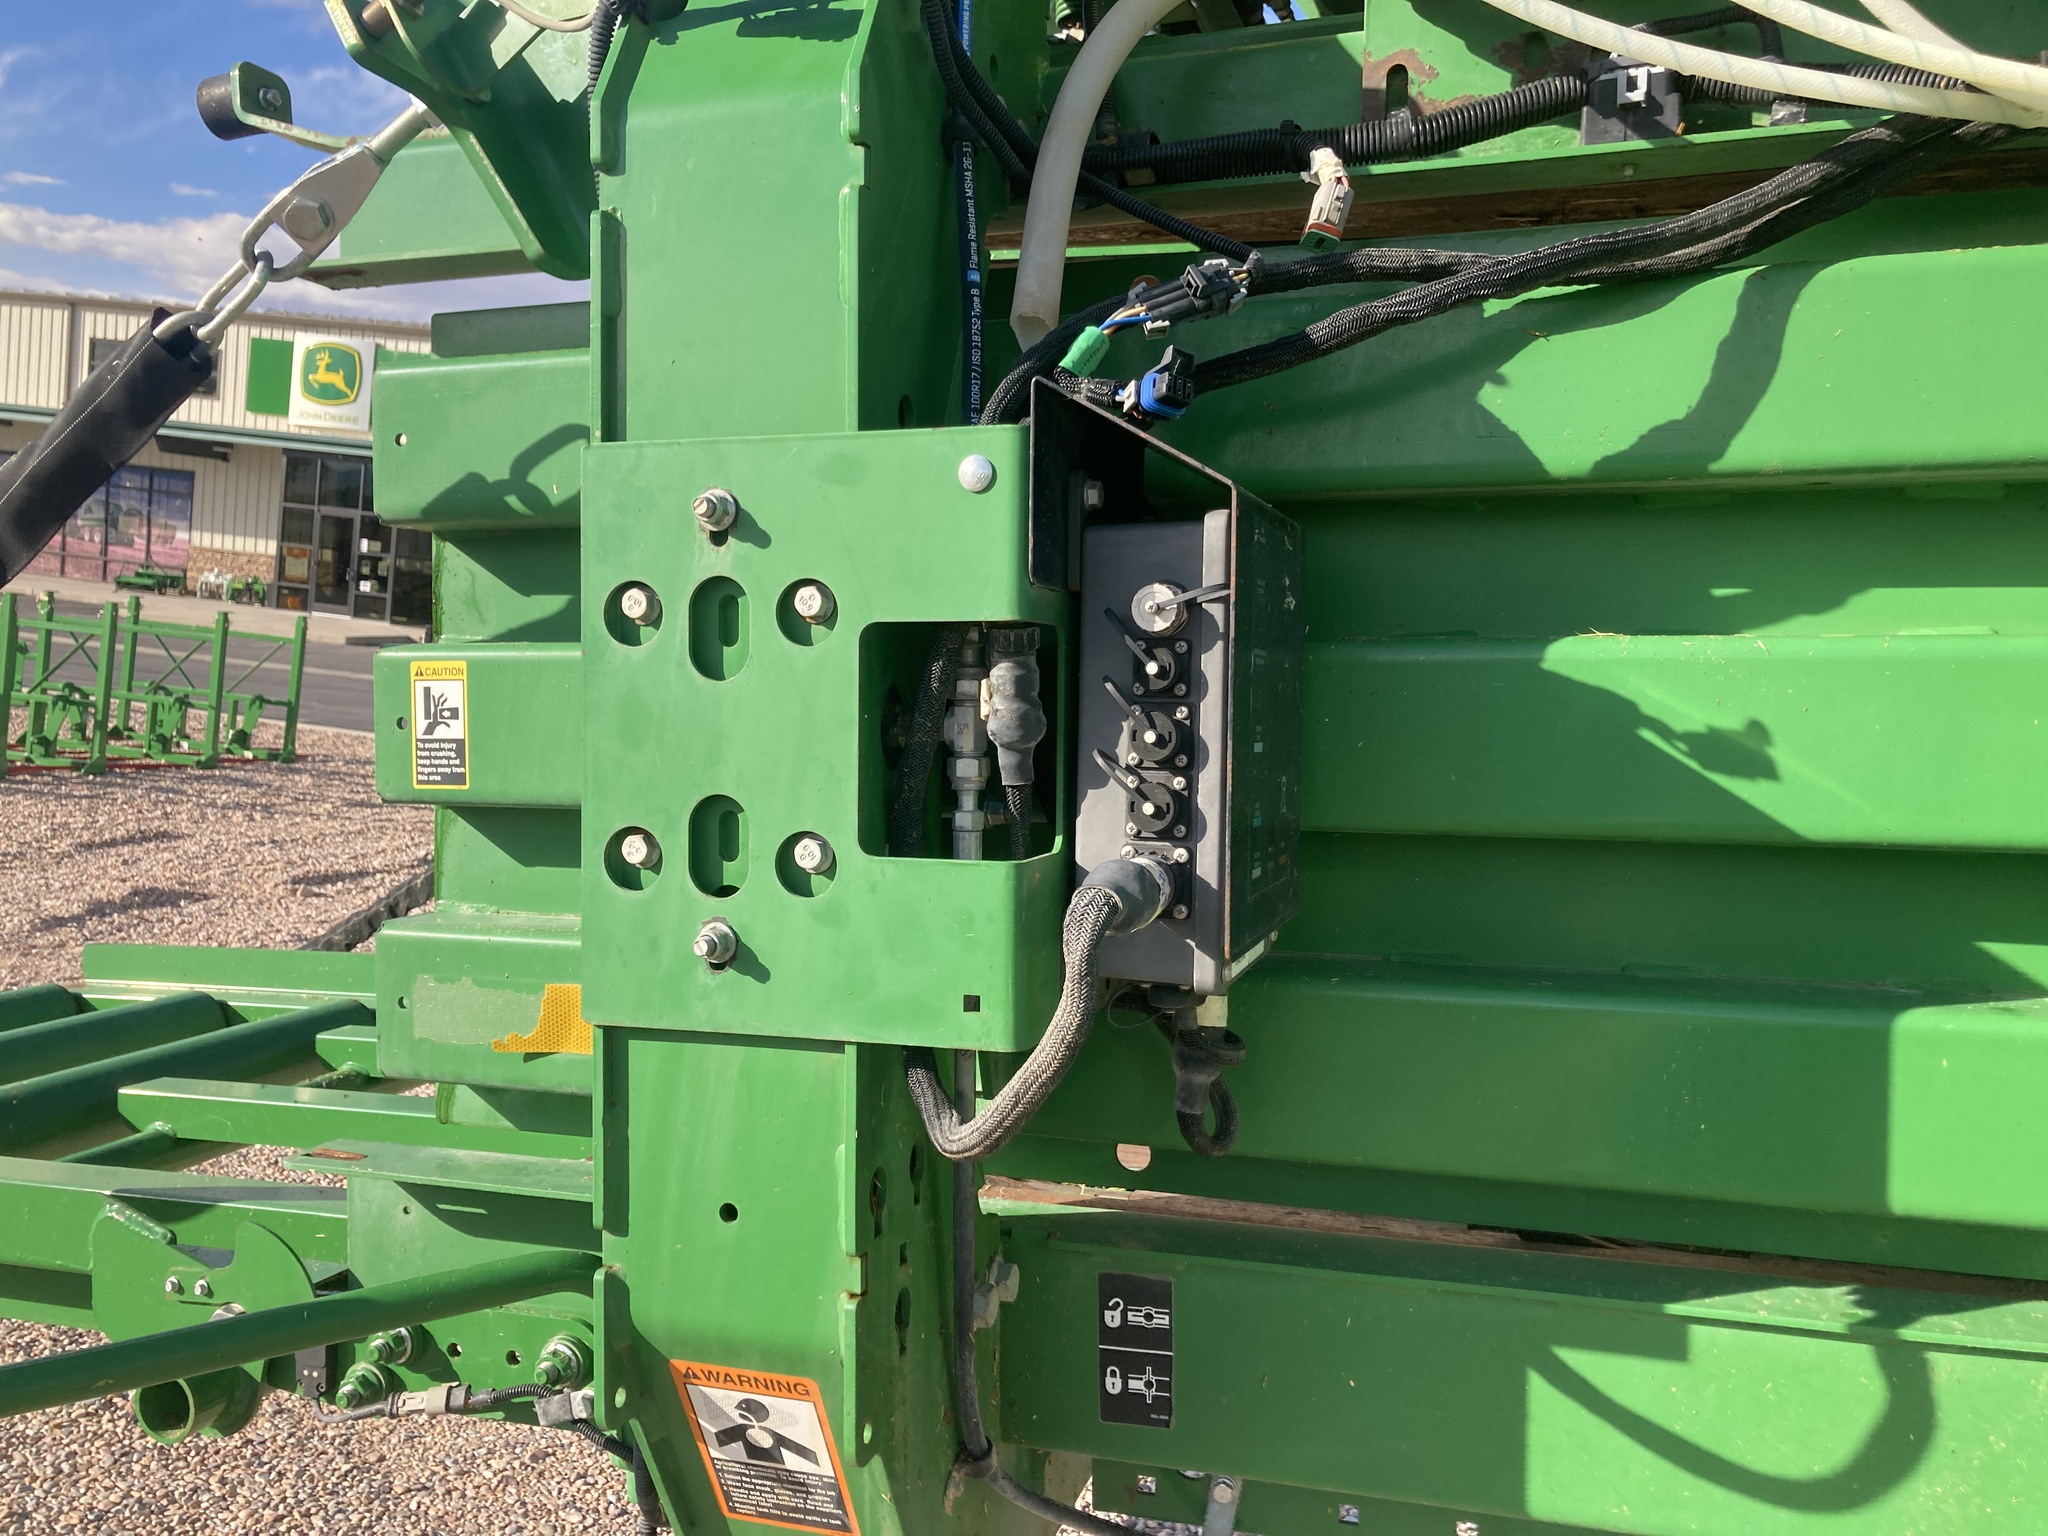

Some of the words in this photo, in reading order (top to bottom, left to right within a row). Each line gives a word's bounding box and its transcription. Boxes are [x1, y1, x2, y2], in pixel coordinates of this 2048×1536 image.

[962, 142, 972, 170] 2G-11
[964, 172, 974, 197] MSHA
[966, 198, 976, 240] Resistant
[969, 242, 978, 268] Flame
[972, 296, 982, 316] Type
[972, 318, 982, 348] 18752
[971, 349, 981, 364] ISO
[971, 372, 981, 410] 100R17
[296, 408, 322, 422] JOHN
[424, 667, 464, 677] CAUTION
[440, 742, 456, 750] injury
[700, 1368, 810, 1397] WARNING
